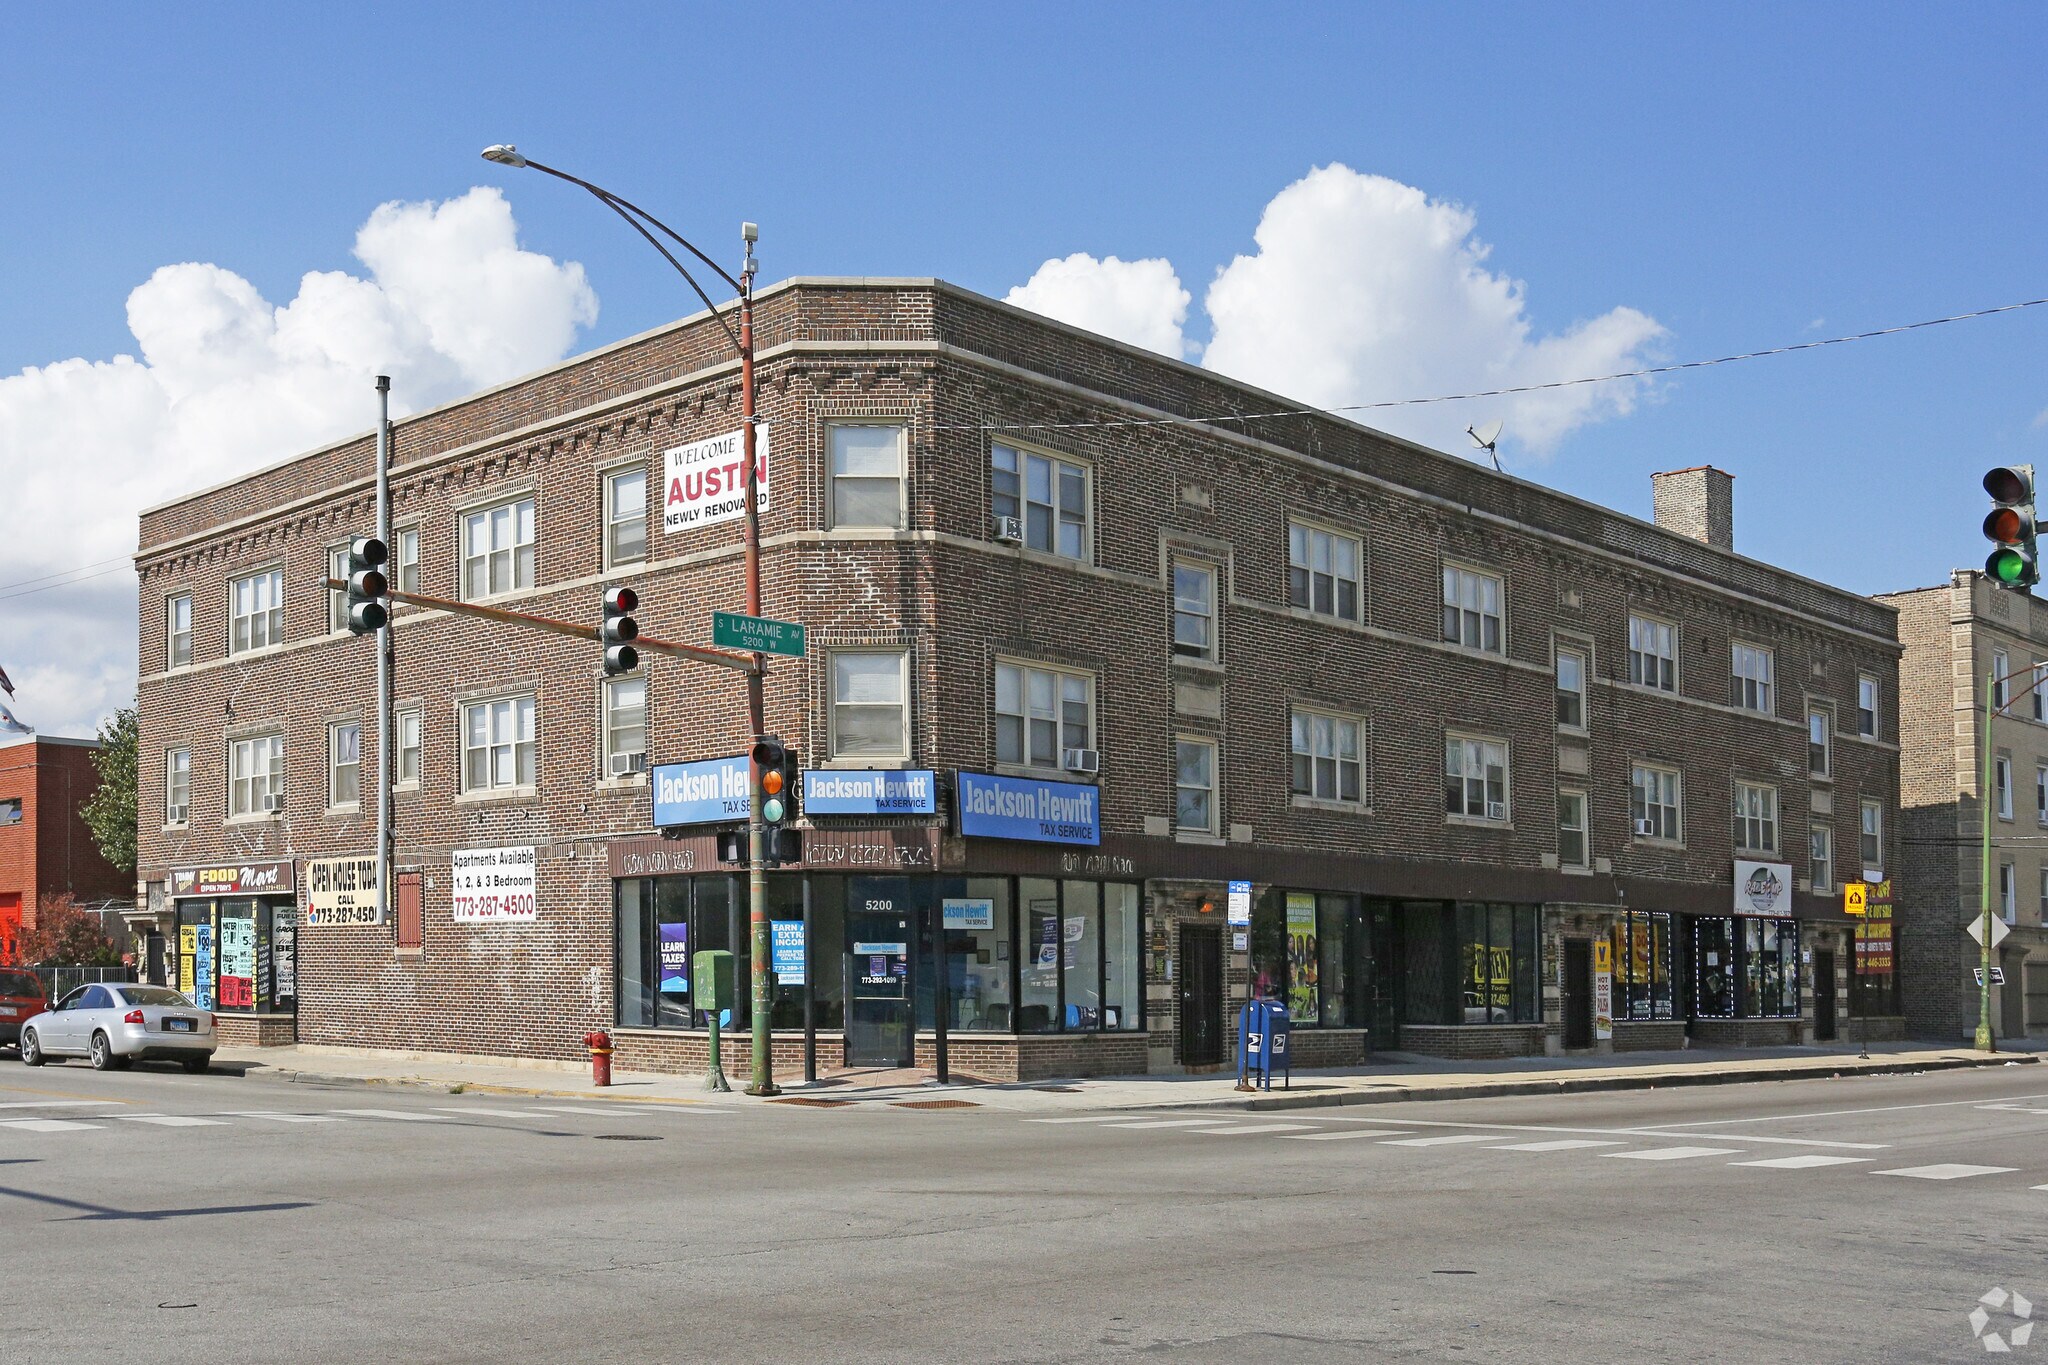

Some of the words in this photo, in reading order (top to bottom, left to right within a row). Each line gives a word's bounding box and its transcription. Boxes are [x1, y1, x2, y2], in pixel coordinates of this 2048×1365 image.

[674, 438, 736, 466] WELCOME
[666, 508, 700, 527] NEWLY
[704, 492, 767, 518] RENOVAD
[718, 619, 724, 628] S
[732, 618, 782, 639] LARAMIE
[791, 630, 800, 639] AV
[742, 636, 763, 648] 5200
[769, 640, 776, 650] W
[657, 770, 719, 805] Jackson
[809, 777, 872, 799] Jackson
[875, 777, 926, 798] Hewitt
[722, 801, 739, 814] TAX
[876, 799, 890, 808] TAX
[892, 799, 926, 808] SERVICE
[966, 780, 1035, 819] Jackson
[1038, 788, 1092, 824] Hewitt
[1040, 823, 1055, 836] TAX
[1058, 825, 1092, 839] SERVICE
[453, 853, 497, 870] Apartments
[499, 850, 534, 865] Available
[200, 868, 238, 883] FOOD
[240, 865, 278, 887] Mart
[312, 863, 331, 893] OPEN
[332, 861, 356, 892] HOUSE
[357, 860, 378, 891] TODA
[476, 875, 482, 888] &
[485, 875, 491, 887] 3
[494, 874, 532, 887] Bedroom
[200, 884, 216, 892] OPEN
[337, 895, 355, 905] CALL
[455, 893, 534, 917] 773-287-4500
[865, 900, 892, 910] 5200
[315, 906, 377, 923] 773-287-450
[222, 922, 238, 931] WATER
[660, 942, 686, 953] LEARN
[661, 953, 686, 964] TAXES
